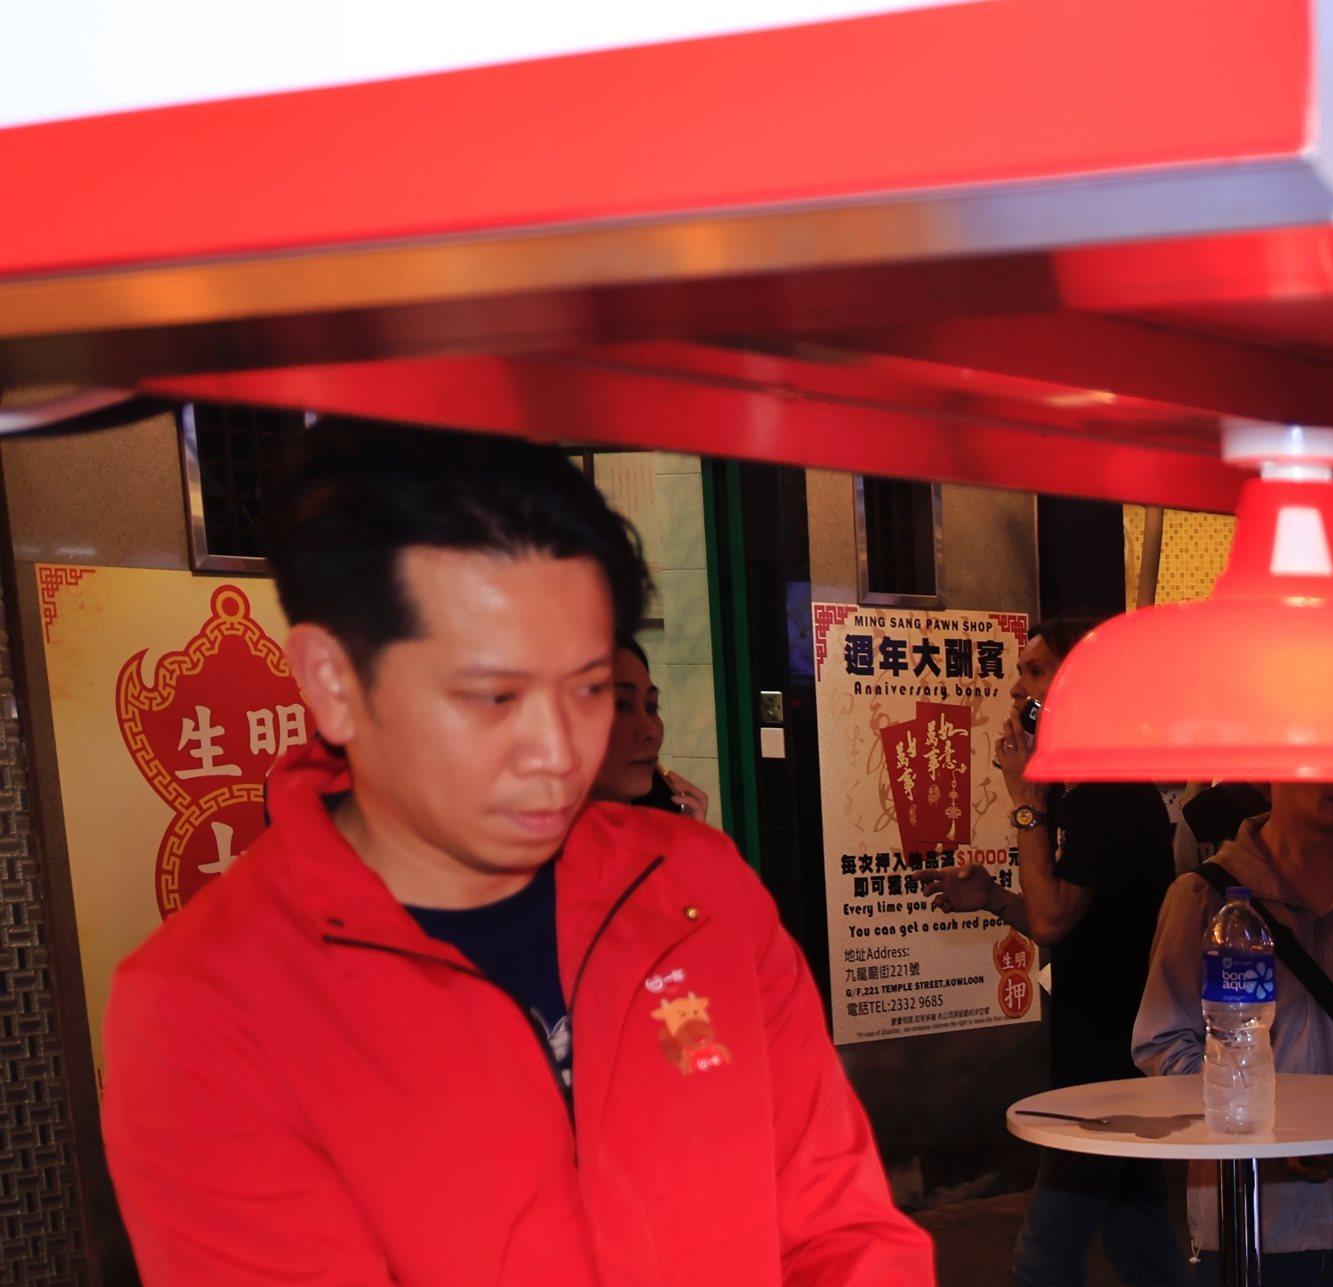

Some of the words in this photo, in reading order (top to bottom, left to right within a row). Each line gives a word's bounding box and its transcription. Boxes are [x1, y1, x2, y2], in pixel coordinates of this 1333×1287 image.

[854, 615, 886, 628] MING
[890, 617, 921, 629] SANG
[926, 619, 959, 631] PAWN
[963, 621, 993, 632] SHOP
[844, 633, 1005, 680] 週年大酬賓
[854, 681, 948, 700] Anniversary
[955, 684, 999, 697] bonus
[843, 903, 873, 917] Every
[877, 901, 903, 912] time
[906, 901, 927, 914] you
[849, 925, 870, 937] You
[874, 925, 896, 935] can
[900, 921, 918, 937] get
[922, 923, 929, 932] a
[933, 919, 958, 931] cash
[962, 917, 979, 929] red
[882, 982, 913, 994] TEMPLE
[1004, 978, 1026, 1010] 押
[918, 994, 943, 1009] 9685
